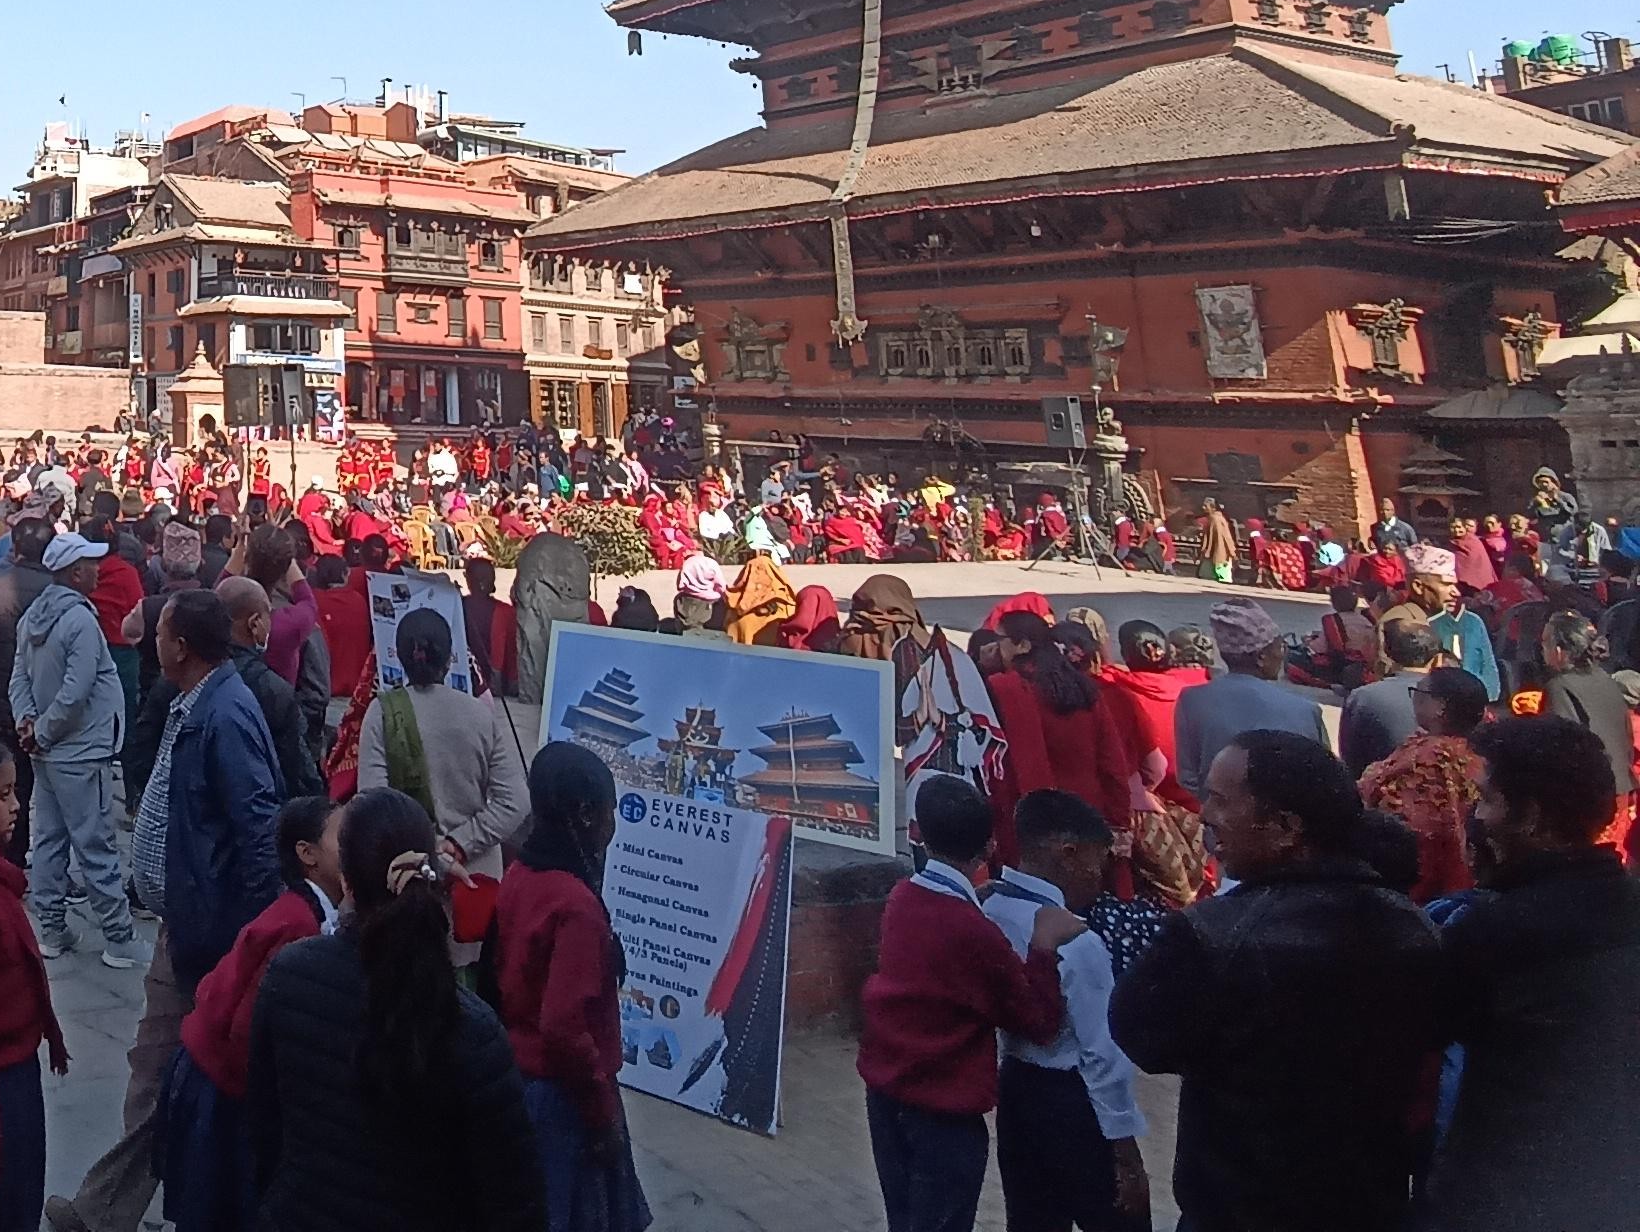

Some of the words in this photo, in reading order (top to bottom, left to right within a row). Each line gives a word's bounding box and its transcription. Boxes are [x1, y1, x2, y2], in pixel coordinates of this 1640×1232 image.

[651, 798, 733, 828] EVEREST
[650, 814, 730, 844] CANVAS
[622, 842, 645, 857] Mini
[647, 849, 683, 865] Canvas
[620, 864, 660, 882] Circular
[662, 875, 700, 892] Canvas
[617, 886, 670, 907] Hexagonal
[672, 900, 709, 918] Canvas
[615, 908, 646, 924] Single
[649, 916, 677, 933] Panel
[680, 925, 718, 944] Canvas
[619, 932, 640, 947] ulti
[642, 938, 671, 955] Panel
[673, 948, 711, 966] Canvas
[649, 974, 698, 998] Paintings
